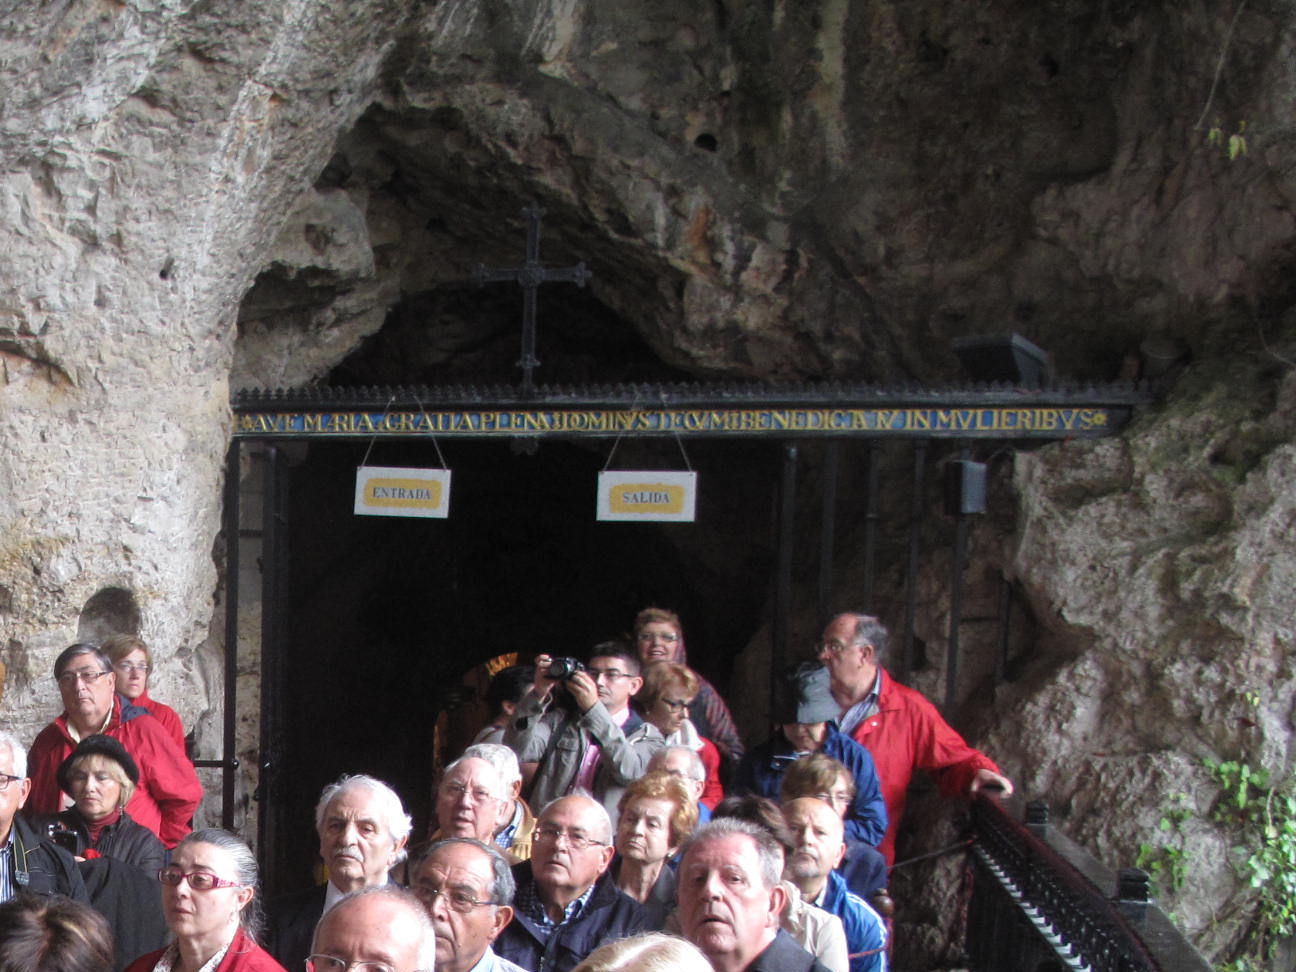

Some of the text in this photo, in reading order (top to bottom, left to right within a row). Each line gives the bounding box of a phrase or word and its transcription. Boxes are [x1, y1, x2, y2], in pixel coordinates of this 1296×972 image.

[253, 413, 299, 432] AVE
[303, 413, 374, 432] MARIA
[385, 412, 474, 431] GRATIA
[479, 411, 551, 431] PLENA
[904, 410, 931, 430] IN
[935, 409, 1093, 430] MVLIERIBVS
[372, 486, 432, 500] ENTRADA
[622, 491, 671, 504] SALIDA
